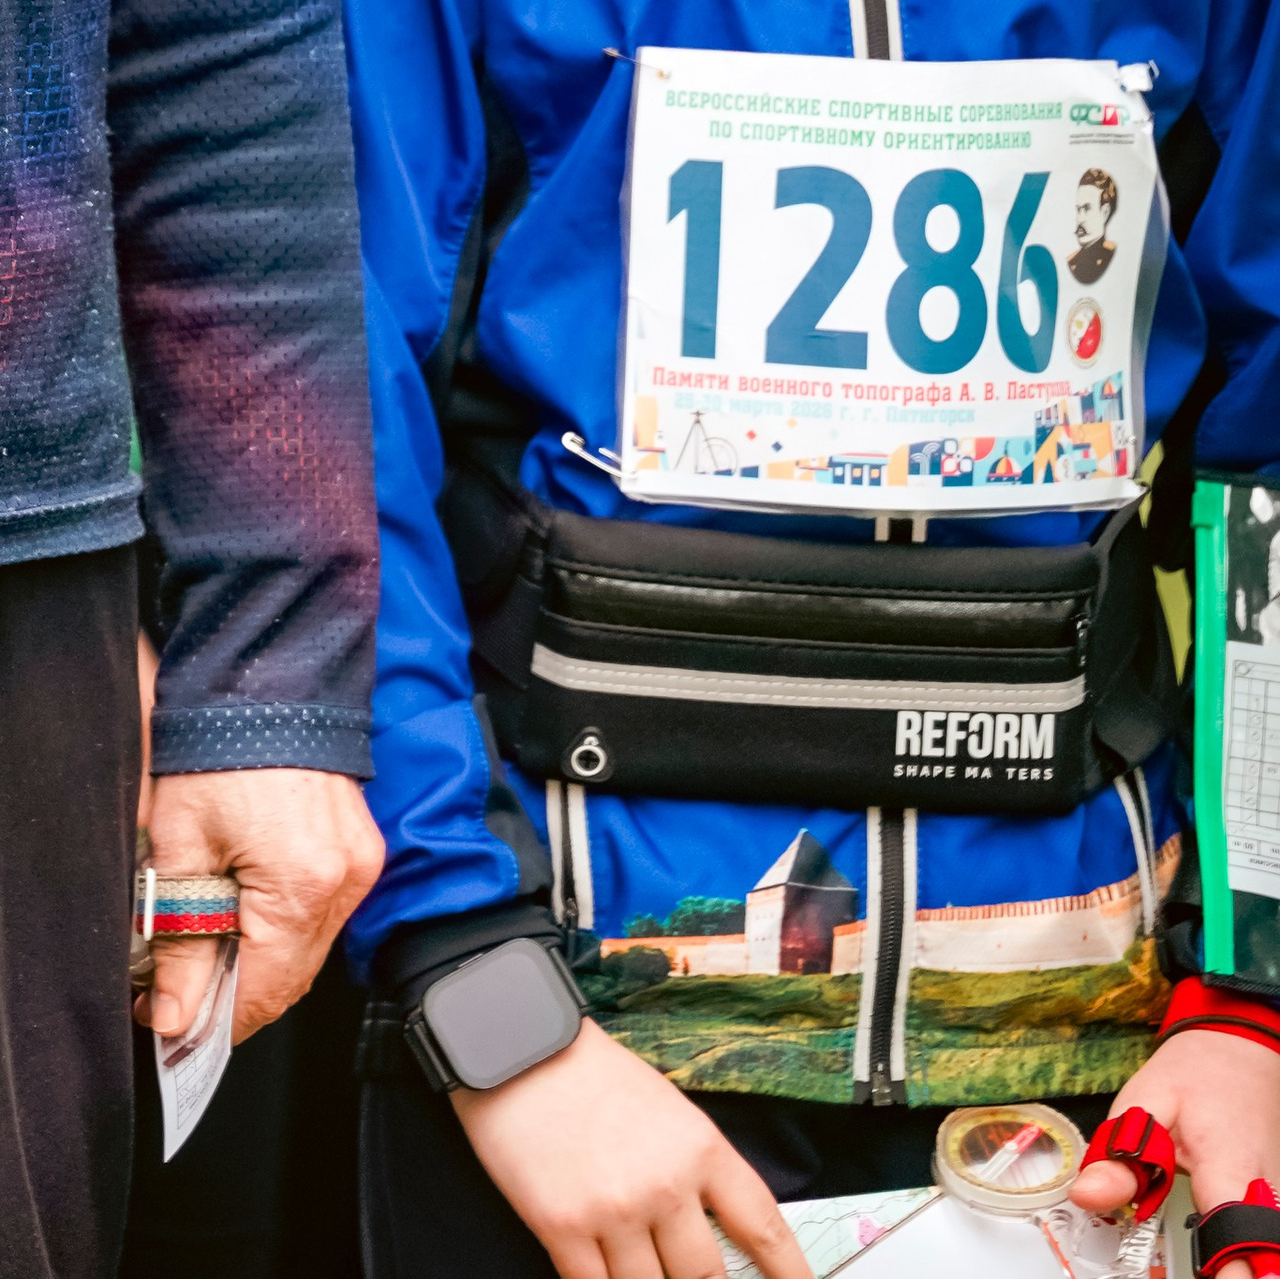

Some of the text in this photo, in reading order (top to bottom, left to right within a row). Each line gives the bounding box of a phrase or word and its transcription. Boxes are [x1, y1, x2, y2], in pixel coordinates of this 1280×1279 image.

[665, 90, 1062, 123] ВСЕРОССИЙСКИЕ СПОРТИВНЫЕ СОРЕВНОВАНИЯ
[709, 120, 1032, 150] ПО СПОРТИВНОМУ ОРИЕНТИРОВАНИЮ
[666, 159, 1058, 375] 1286
[652, 367, 729, 390] Памяти
[739, 376, 833, 398] военного
[841, 382, 952, 406] топографа
[960, 383, 976, 401] А.
[984, 382, 999, 400] В.
[730, 398, 784, 418] марта
[791, 400, 833, 419] 2026
[895, 710, 1056, 759] REFORM
[893, 764, 957, 779] SHAPE
